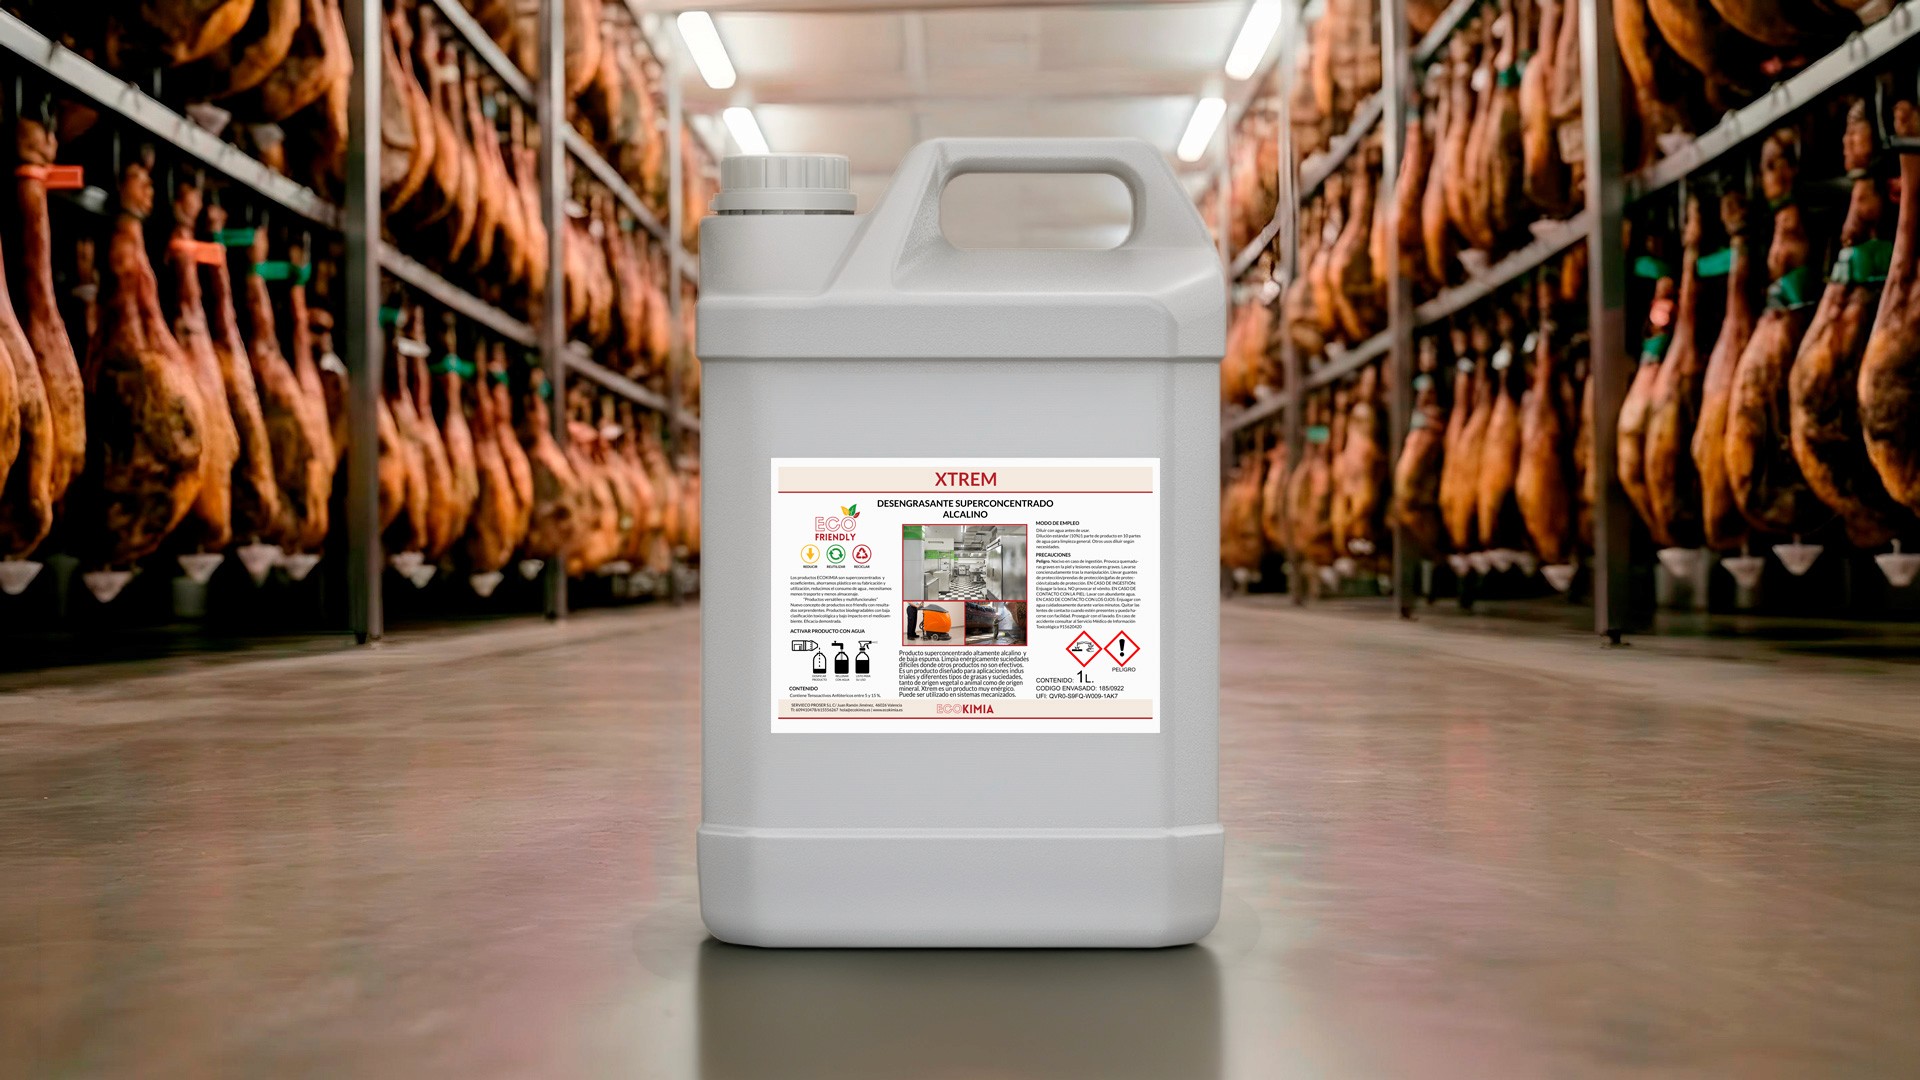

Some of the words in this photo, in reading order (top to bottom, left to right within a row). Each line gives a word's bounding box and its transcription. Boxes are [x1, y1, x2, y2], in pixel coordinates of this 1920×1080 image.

[935, 472, 996, 486] XTREM
[877, 499, 954, 507] DESENGRASANTE
[955, 499, 1054, 507] SUPERCONCENTRADO
[942, 510, 988, 518] ALCALINO
[815, 517, 857, 532] ECO
[815, 533, 856, 541] FRIENDLY
[936, 704, 994, 714] ECOKIMIA
